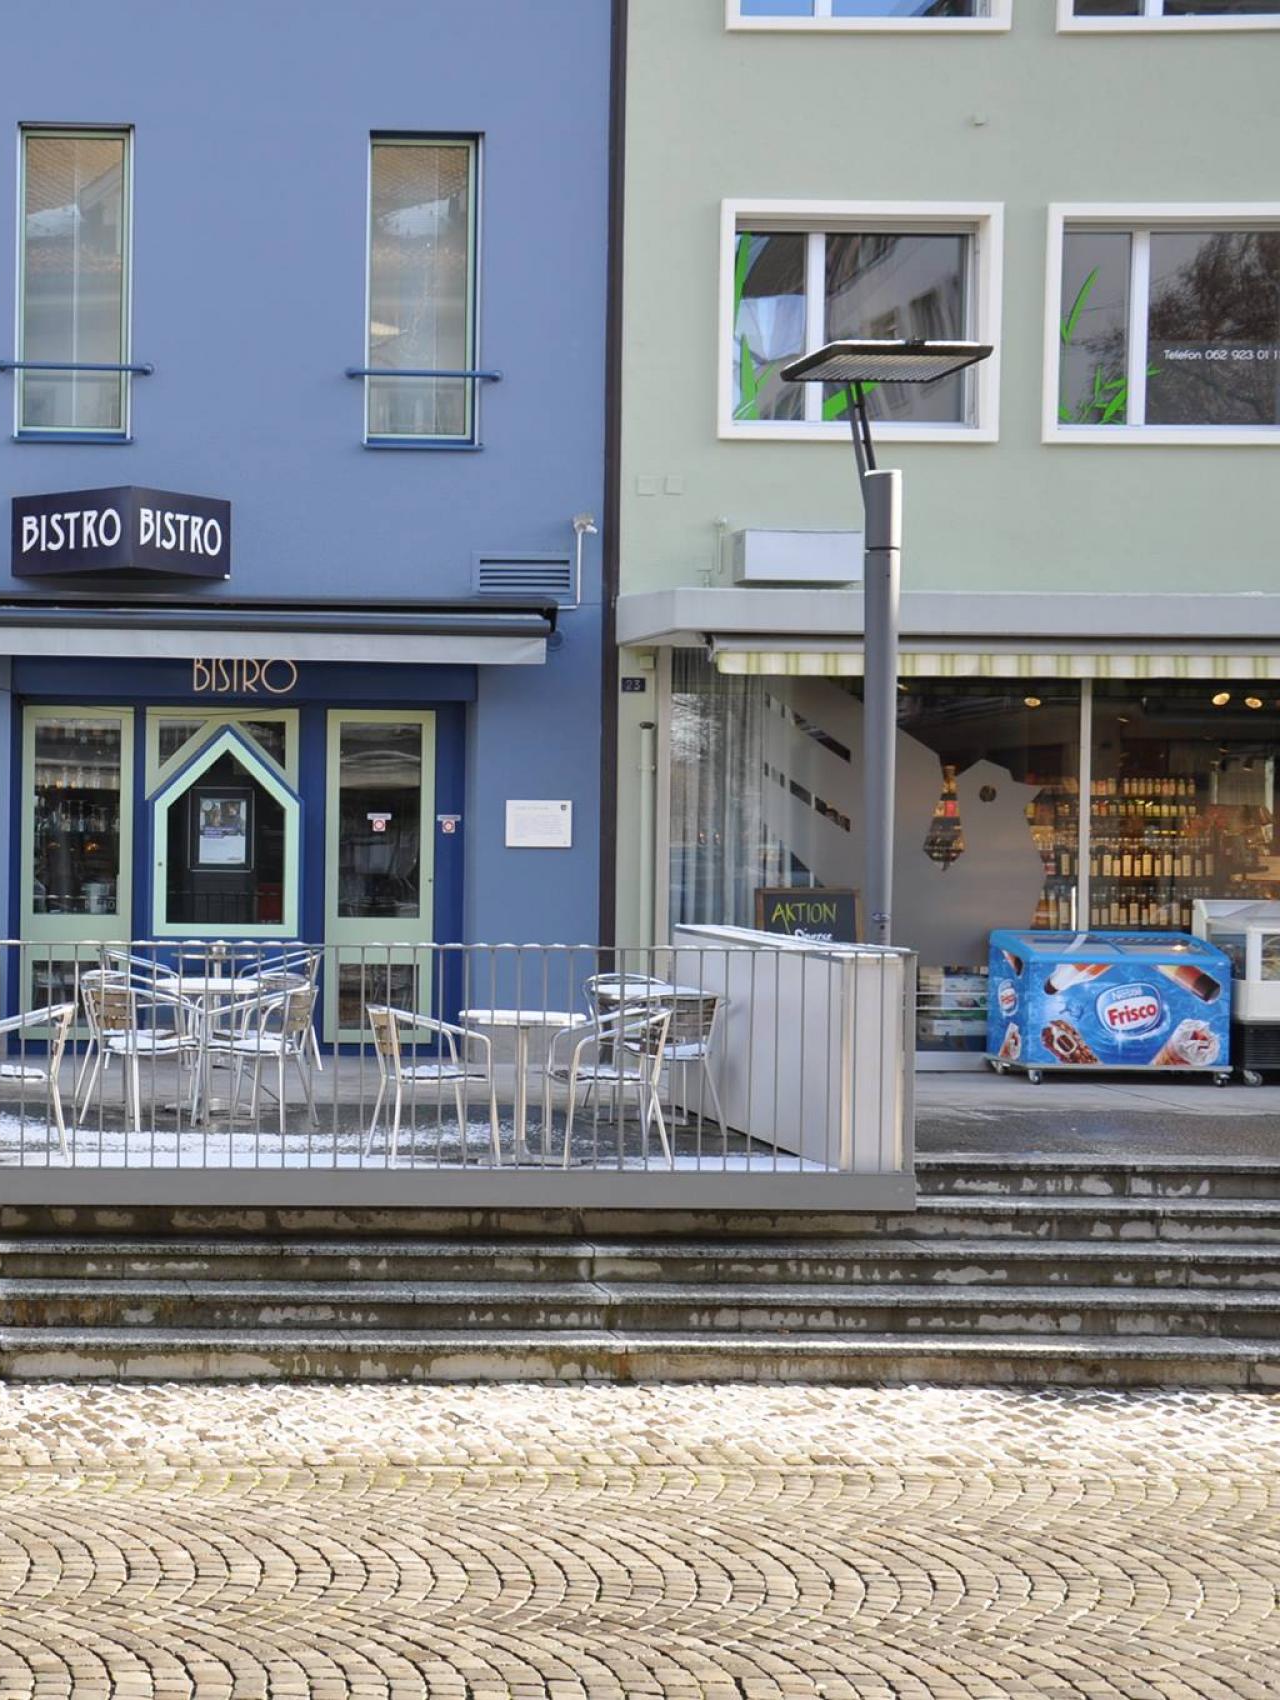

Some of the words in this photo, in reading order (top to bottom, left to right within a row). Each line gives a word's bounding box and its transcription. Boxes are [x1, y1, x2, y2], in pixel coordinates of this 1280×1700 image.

[1164, 349, 1201, 360] Telefon
[1205, 349, 1228, 360] 062
[1231, 349, 1254, 360] 923
[1257, 349, 1269, 360] 01
[22, 508, 121, 553] BISTRO
[140, 508, 222, 556] BISTRO
[193, 658, 297, 693] BISTRO
[771, 902, 836, 934] AKTION
[1108, 1004, 1157, 1026] Frisco
